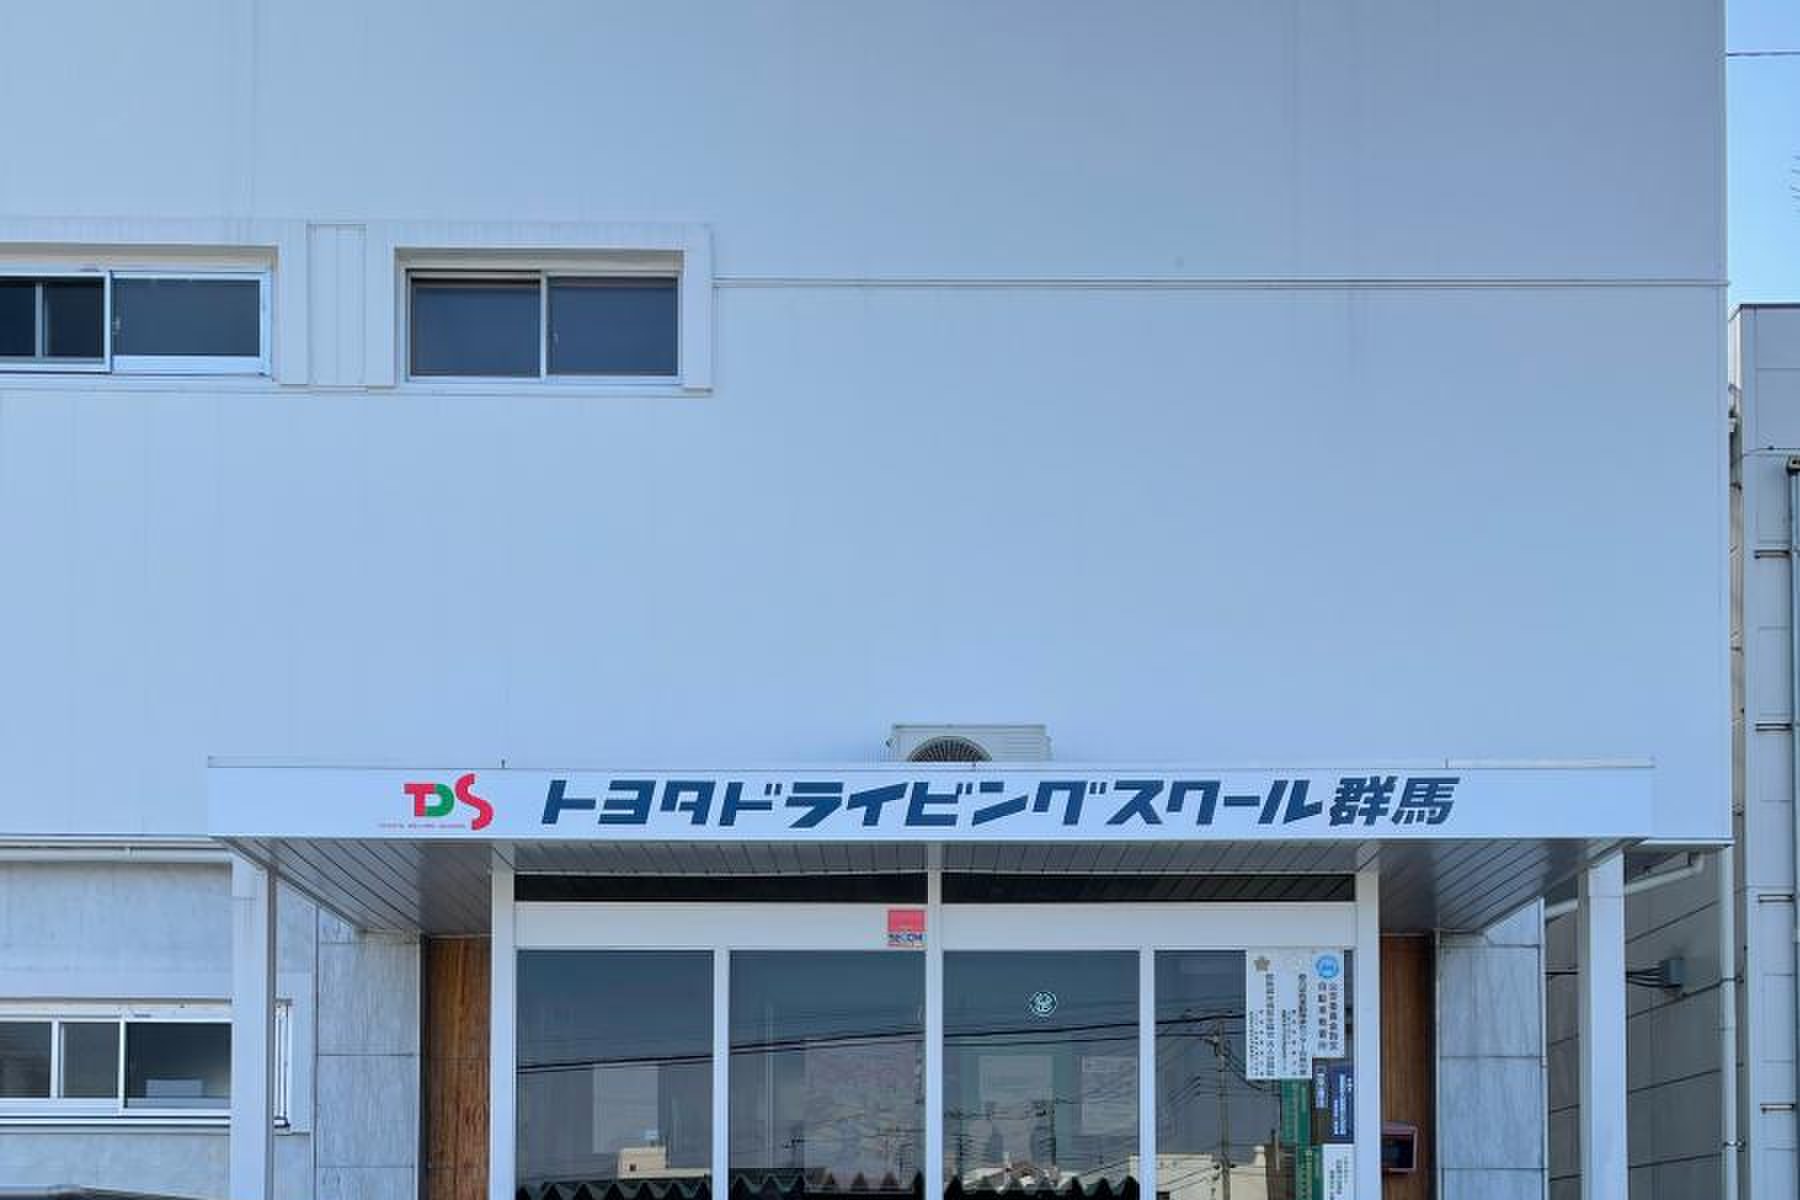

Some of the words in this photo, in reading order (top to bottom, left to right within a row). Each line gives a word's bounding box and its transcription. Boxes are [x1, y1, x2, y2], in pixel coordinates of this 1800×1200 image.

[404, 773, 493, 830] TDS
[541, 776, 1460, 828] トヨタドライビングスクール群馬
